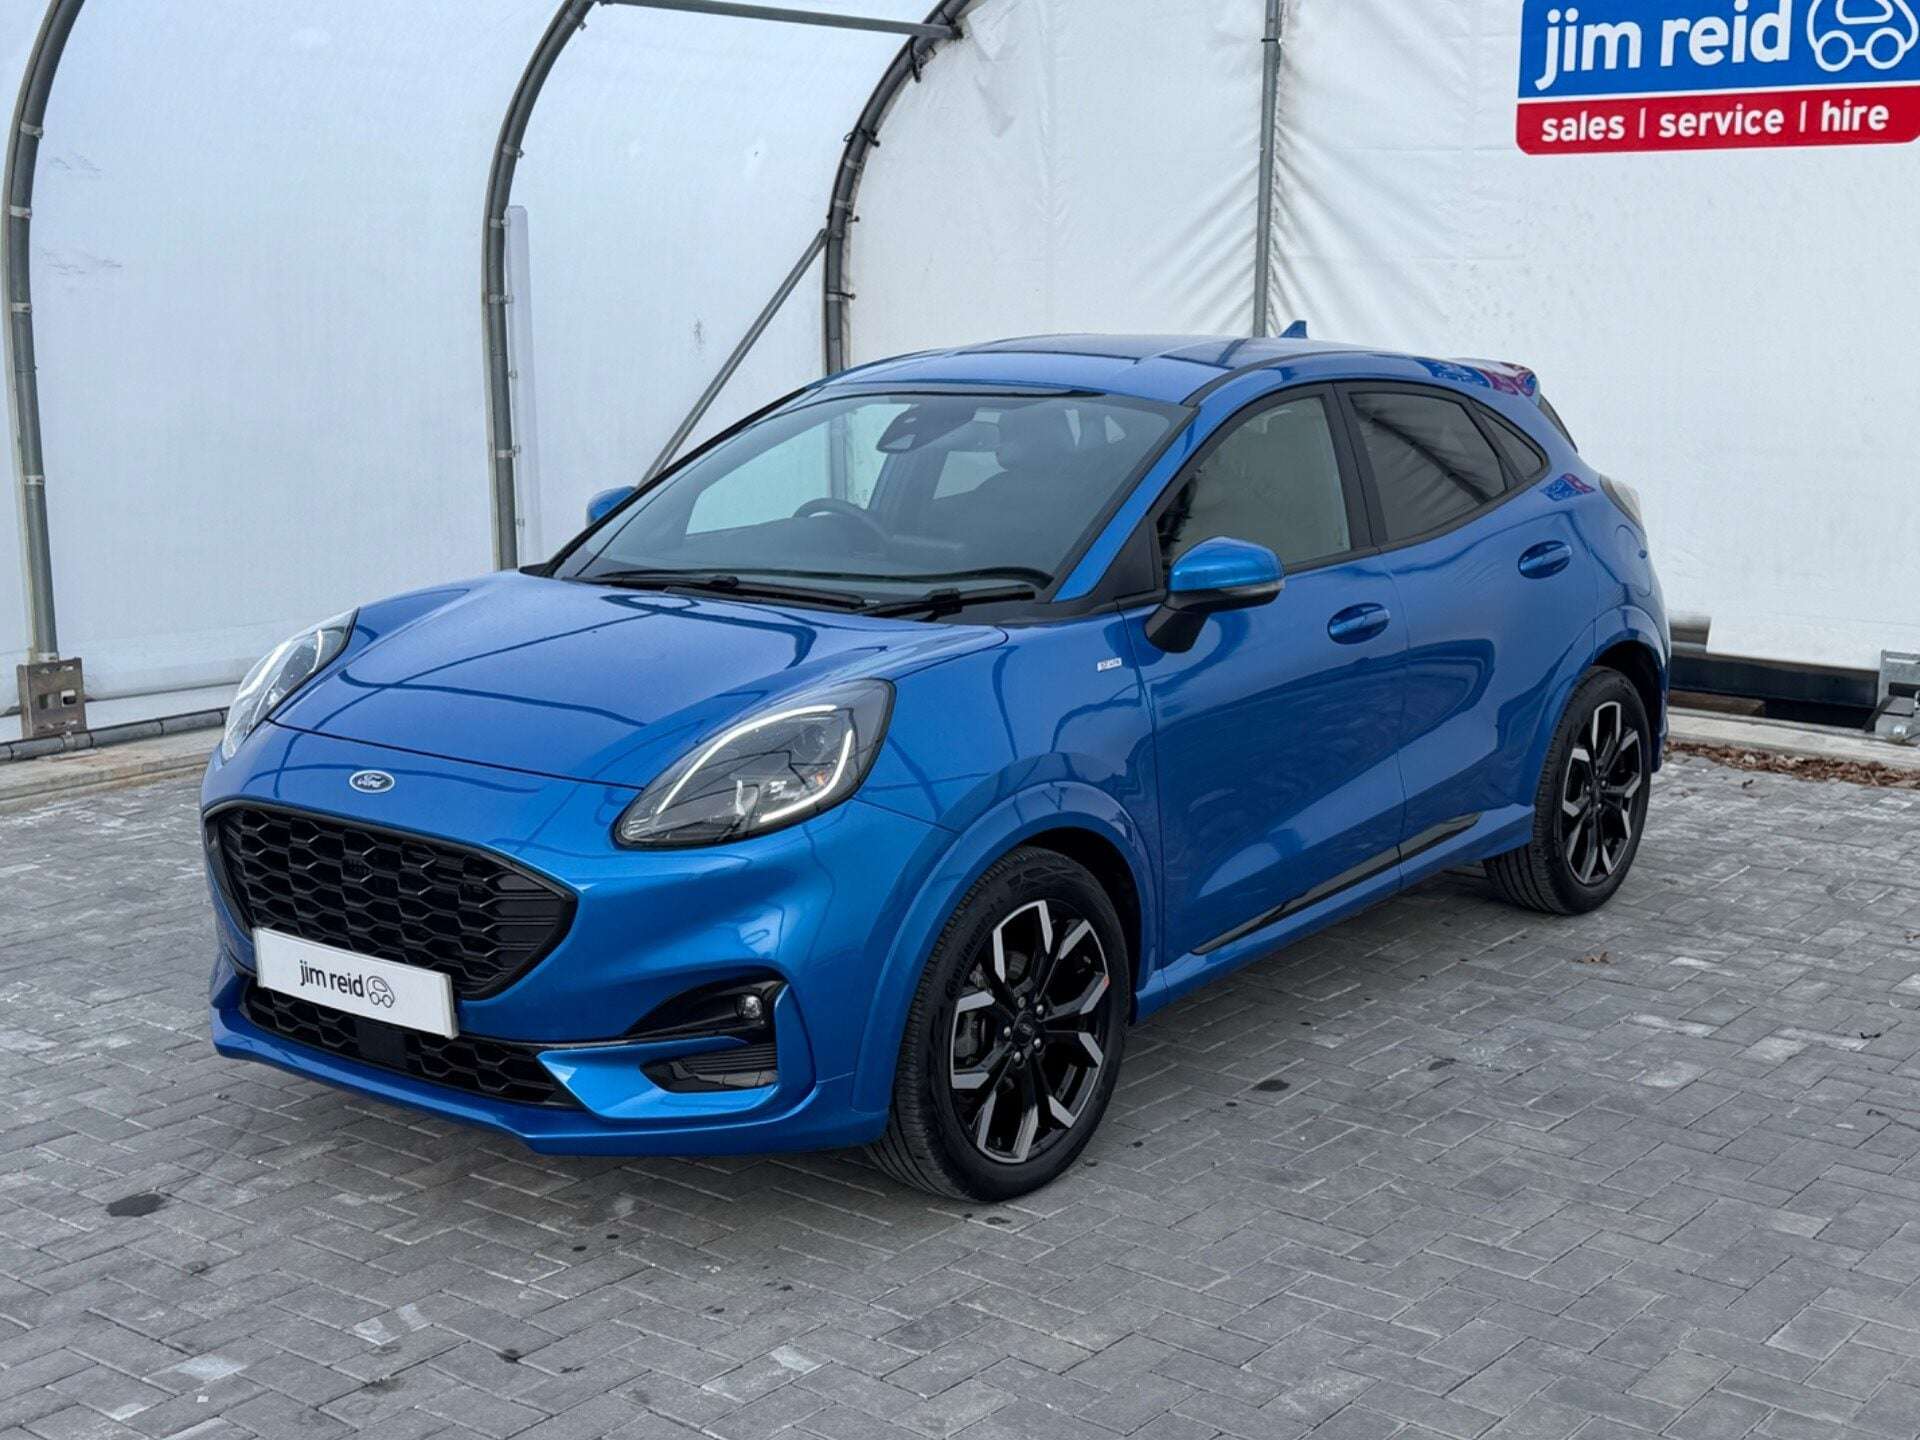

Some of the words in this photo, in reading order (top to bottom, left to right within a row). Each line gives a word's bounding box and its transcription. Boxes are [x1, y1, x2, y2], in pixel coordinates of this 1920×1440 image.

[1534, 7, 1643, 91] jim
[1660, 0, 1791, 67] reid
[1541, 111, 1625, 142] sales
[1658, 104, 1785, 138] service
[1820, 100, 1890, 132] hire
[299, 960, 328, 988] jim
[329, 971, 365, 998] reid
